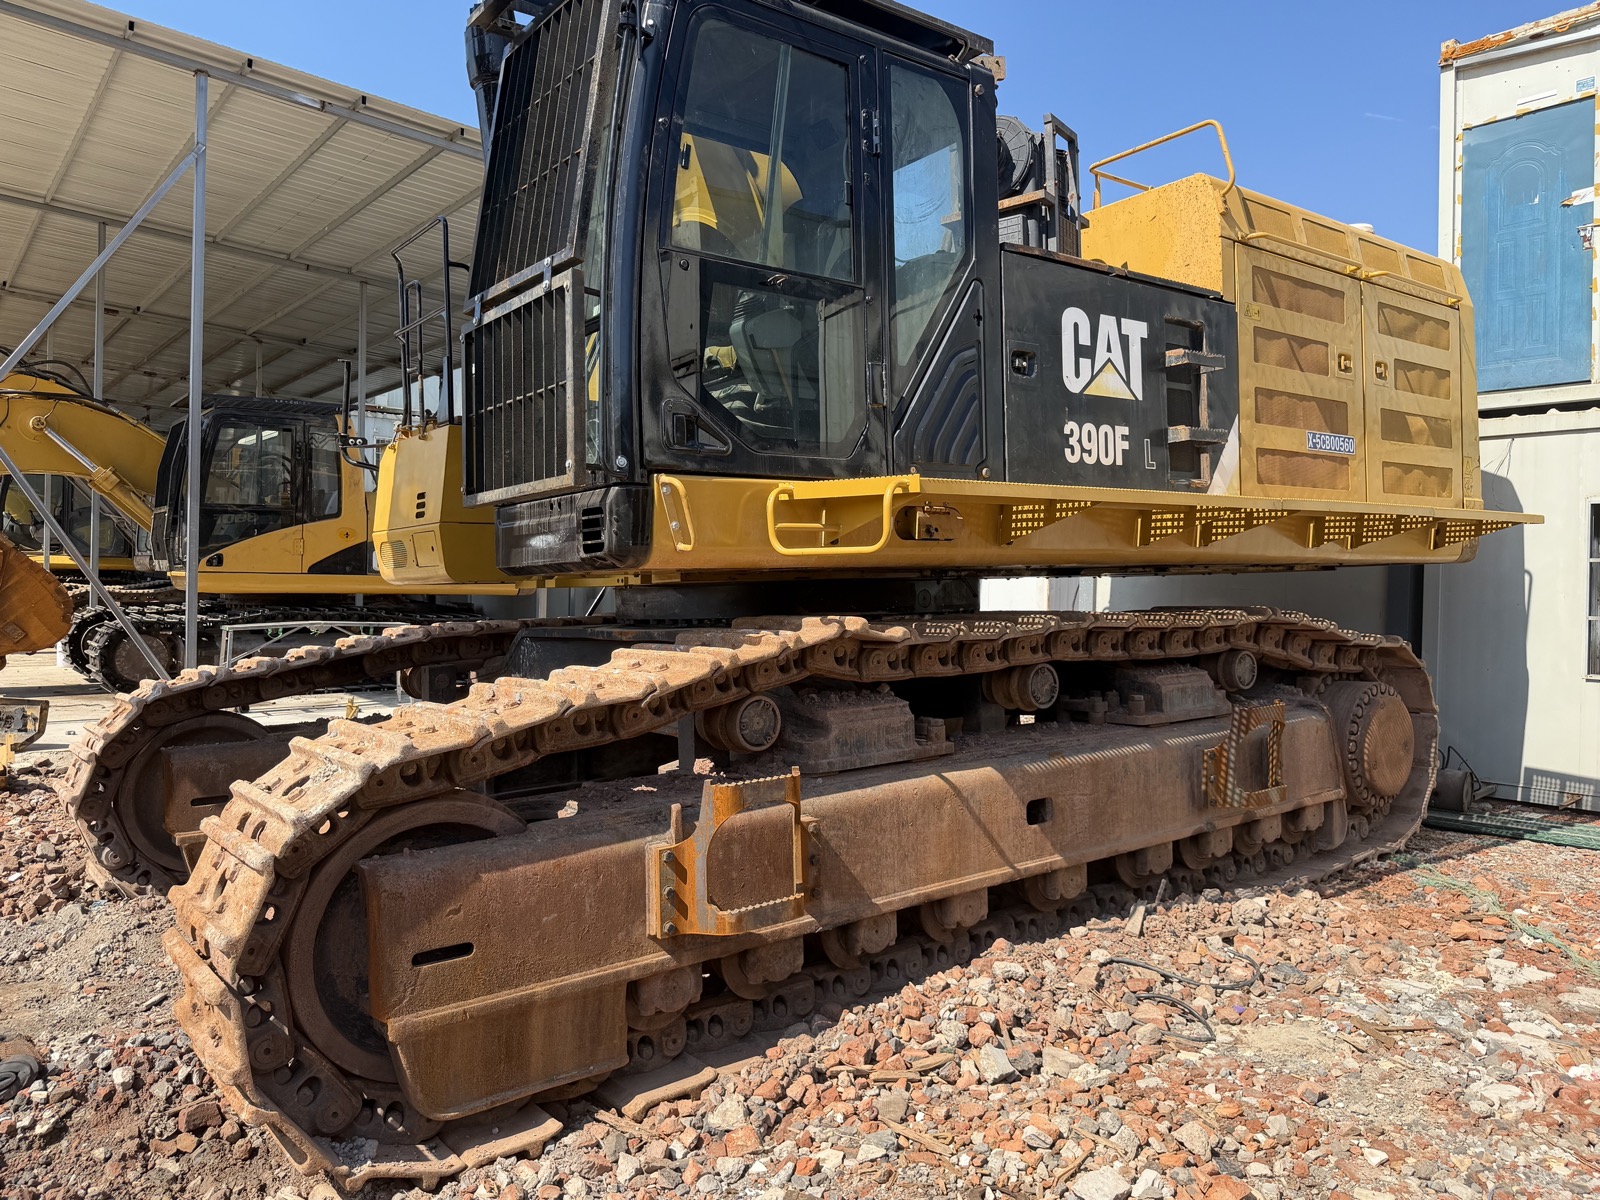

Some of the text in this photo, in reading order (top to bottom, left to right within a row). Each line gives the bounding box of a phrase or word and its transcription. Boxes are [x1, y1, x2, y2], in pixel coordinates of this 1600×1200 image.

[1061, 306, 1148, 401] CAT
[1063, 420, 1157, 470] 390F L
[1307, 432, 1354, 452] X-5CB00560
